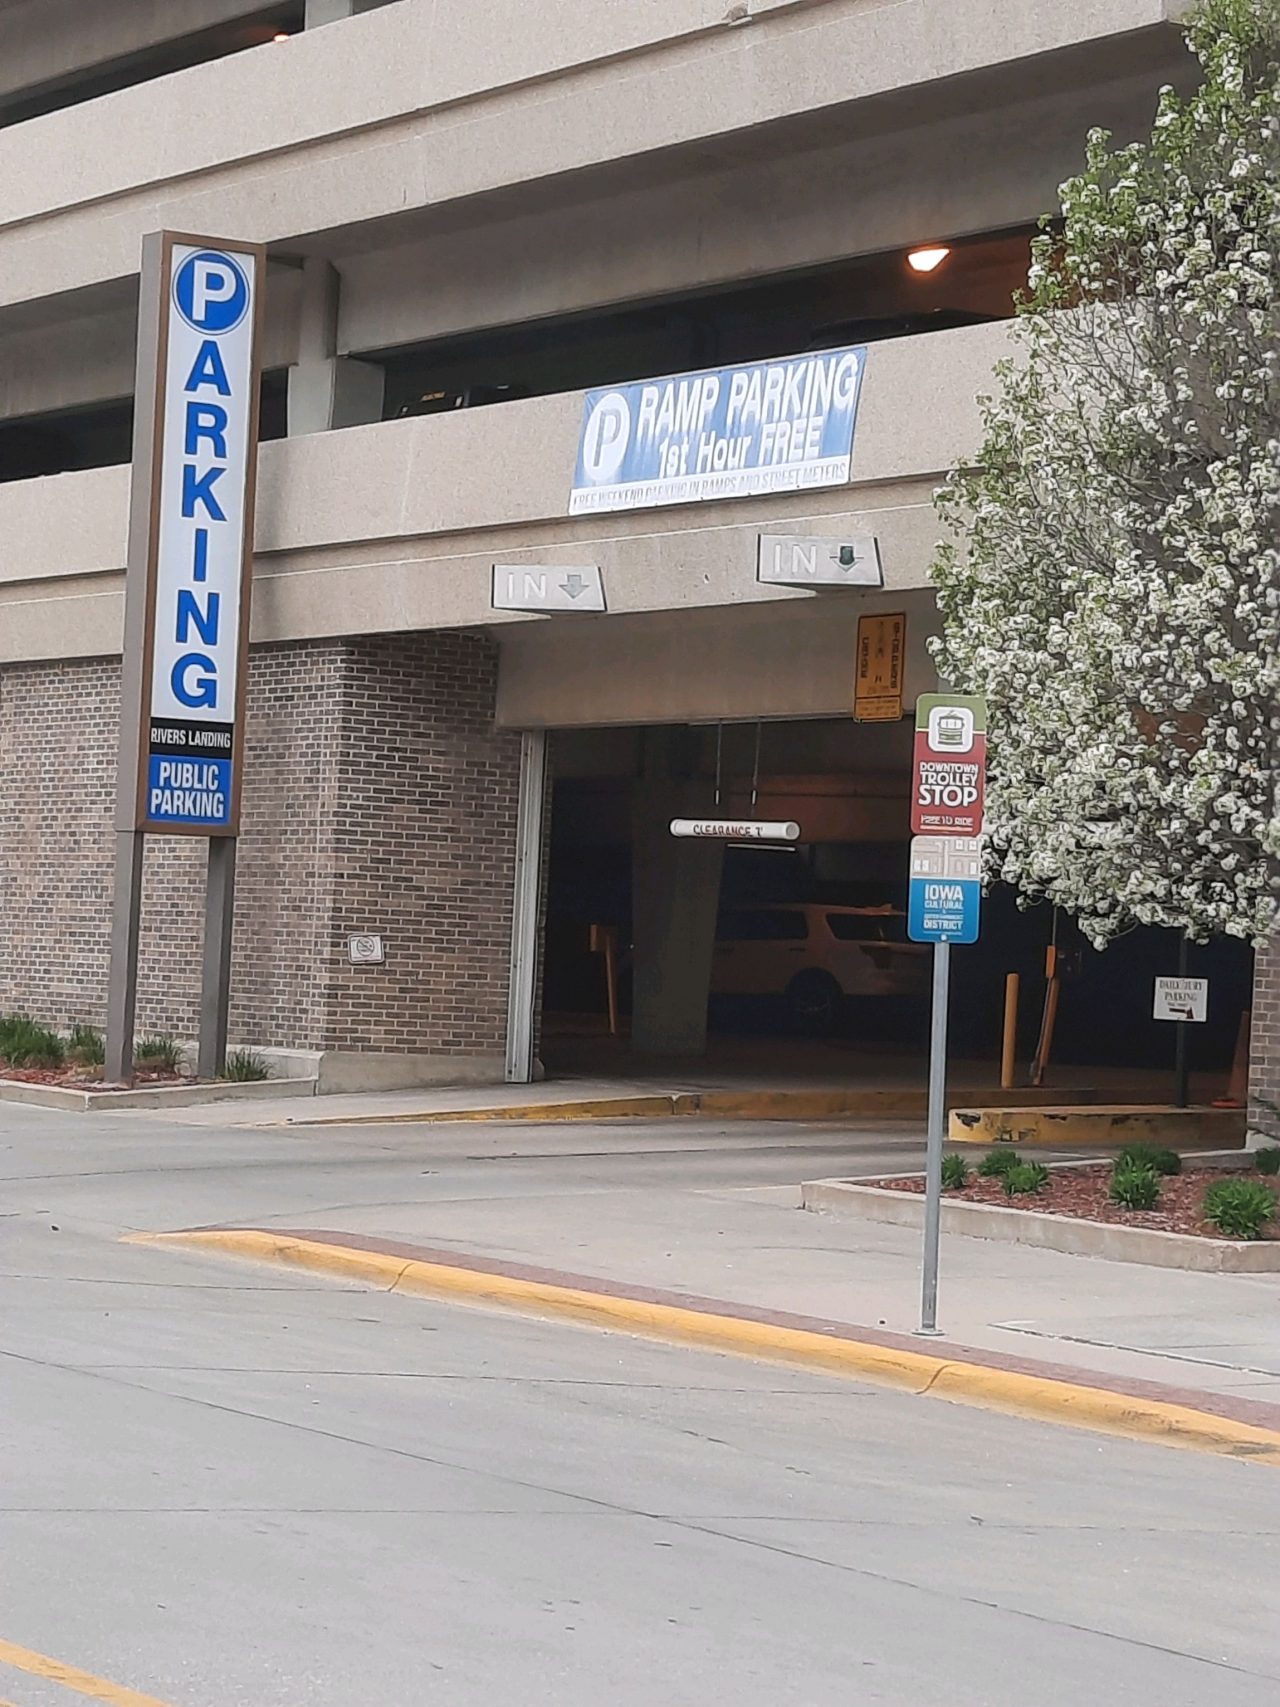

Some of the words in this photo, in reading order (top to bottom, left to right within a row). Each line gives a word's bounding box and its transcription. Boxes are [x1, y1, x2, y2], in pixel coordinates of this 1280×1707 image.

[637, 376, 720, 442] RAMP
[727, 353, 859, 428] PARKING
[659, 437, 690, 478] 1st
[697, 431, 753, 474] Hour
[758, 415, 824, 466] FREE
[170, 259, 239, 709] PARKING
[762, 467, 801, 488] STREET
[773, 543, 818, 575] IN
[507, 572, 547, 600] IN
[151, 728, 187, 745] RIVERS
[188, 730, 231, 748] LANDING
[159, 762, 219, 790] PUBLIC
[920, 762, 978, 773] DOWNTOWN
[920, 771, 978, 787] TROLLEY
[150, 788, 225, 818] PARKING
[918, 785, 978, 807] STOP
[693, 824, 754, 838] CLEARANCE
[924, 884, 964, 901] IOWA
[924, 900, 964, 910] CULTURAL
[923, 919, 963, 930] DISTRICT
